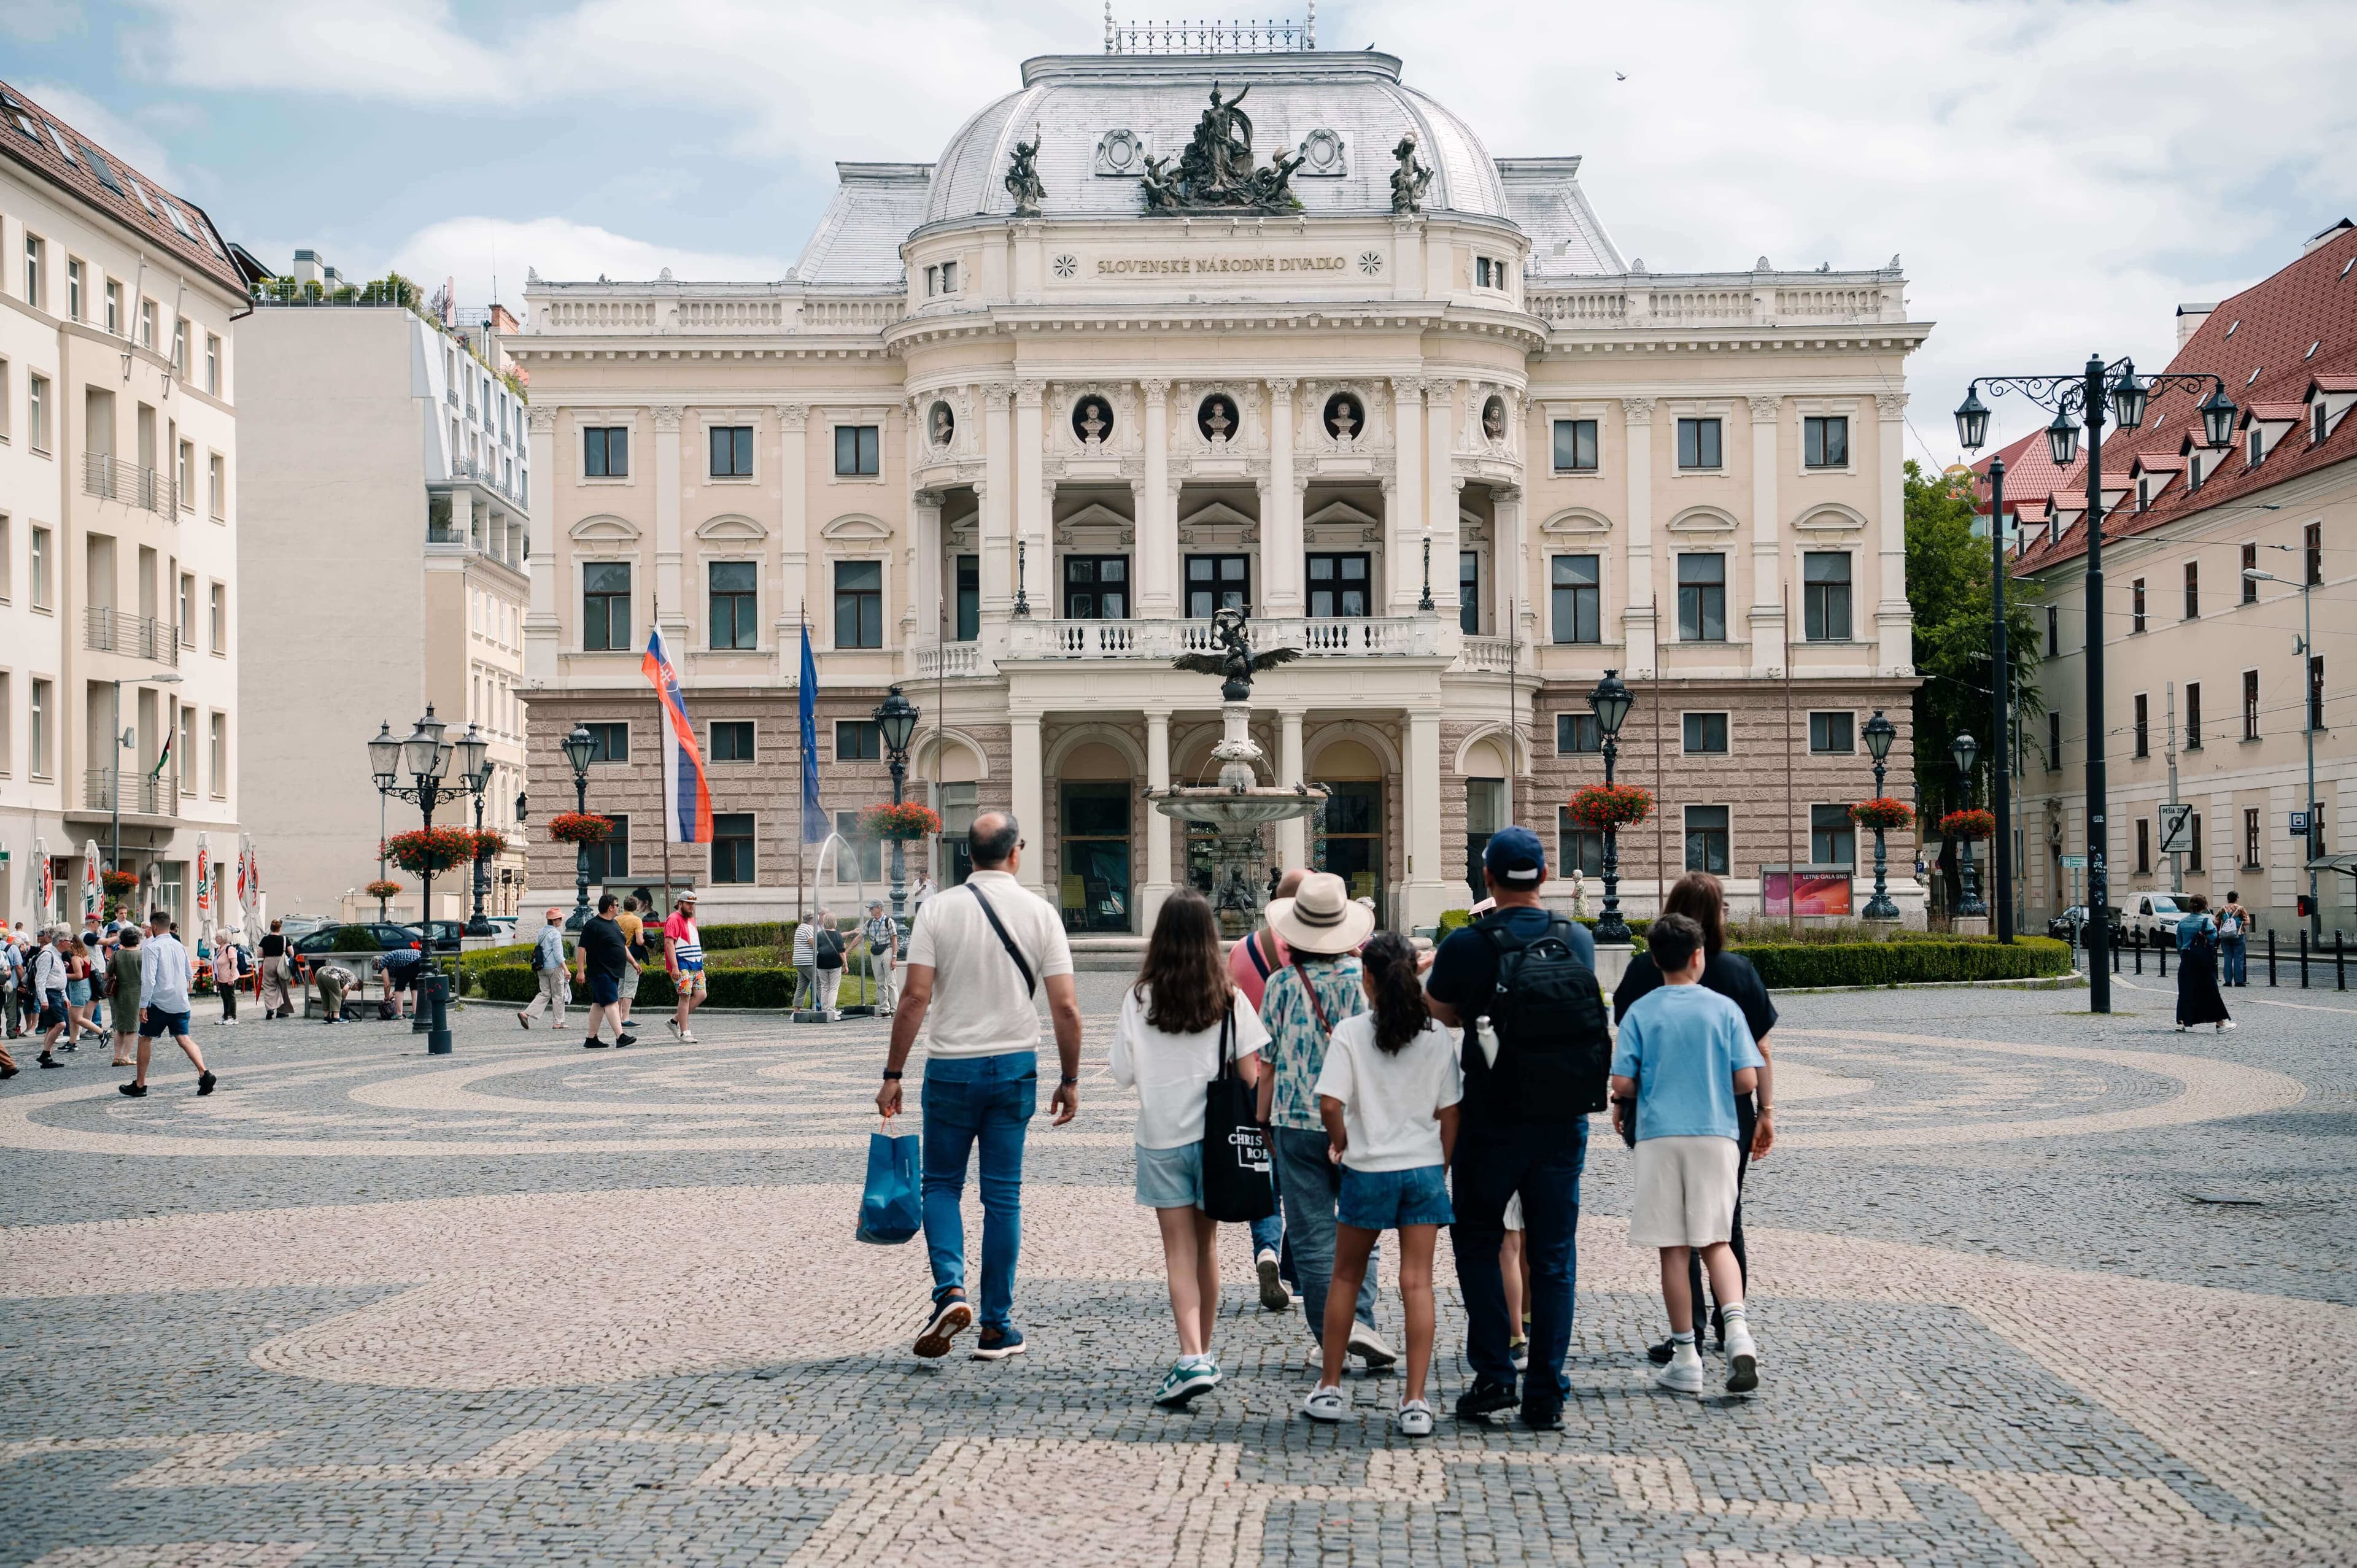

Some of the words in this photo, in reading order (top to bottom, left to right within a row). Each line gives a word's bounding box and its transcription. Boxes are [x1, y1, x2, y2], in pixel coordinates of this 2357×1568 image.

[1097, 256, 1190, 274] SLOVENSKÉ
[1196, 253, 1275, 272] NÁRODNÉ
[1279, 257, 1346, 271] DIVADLO
